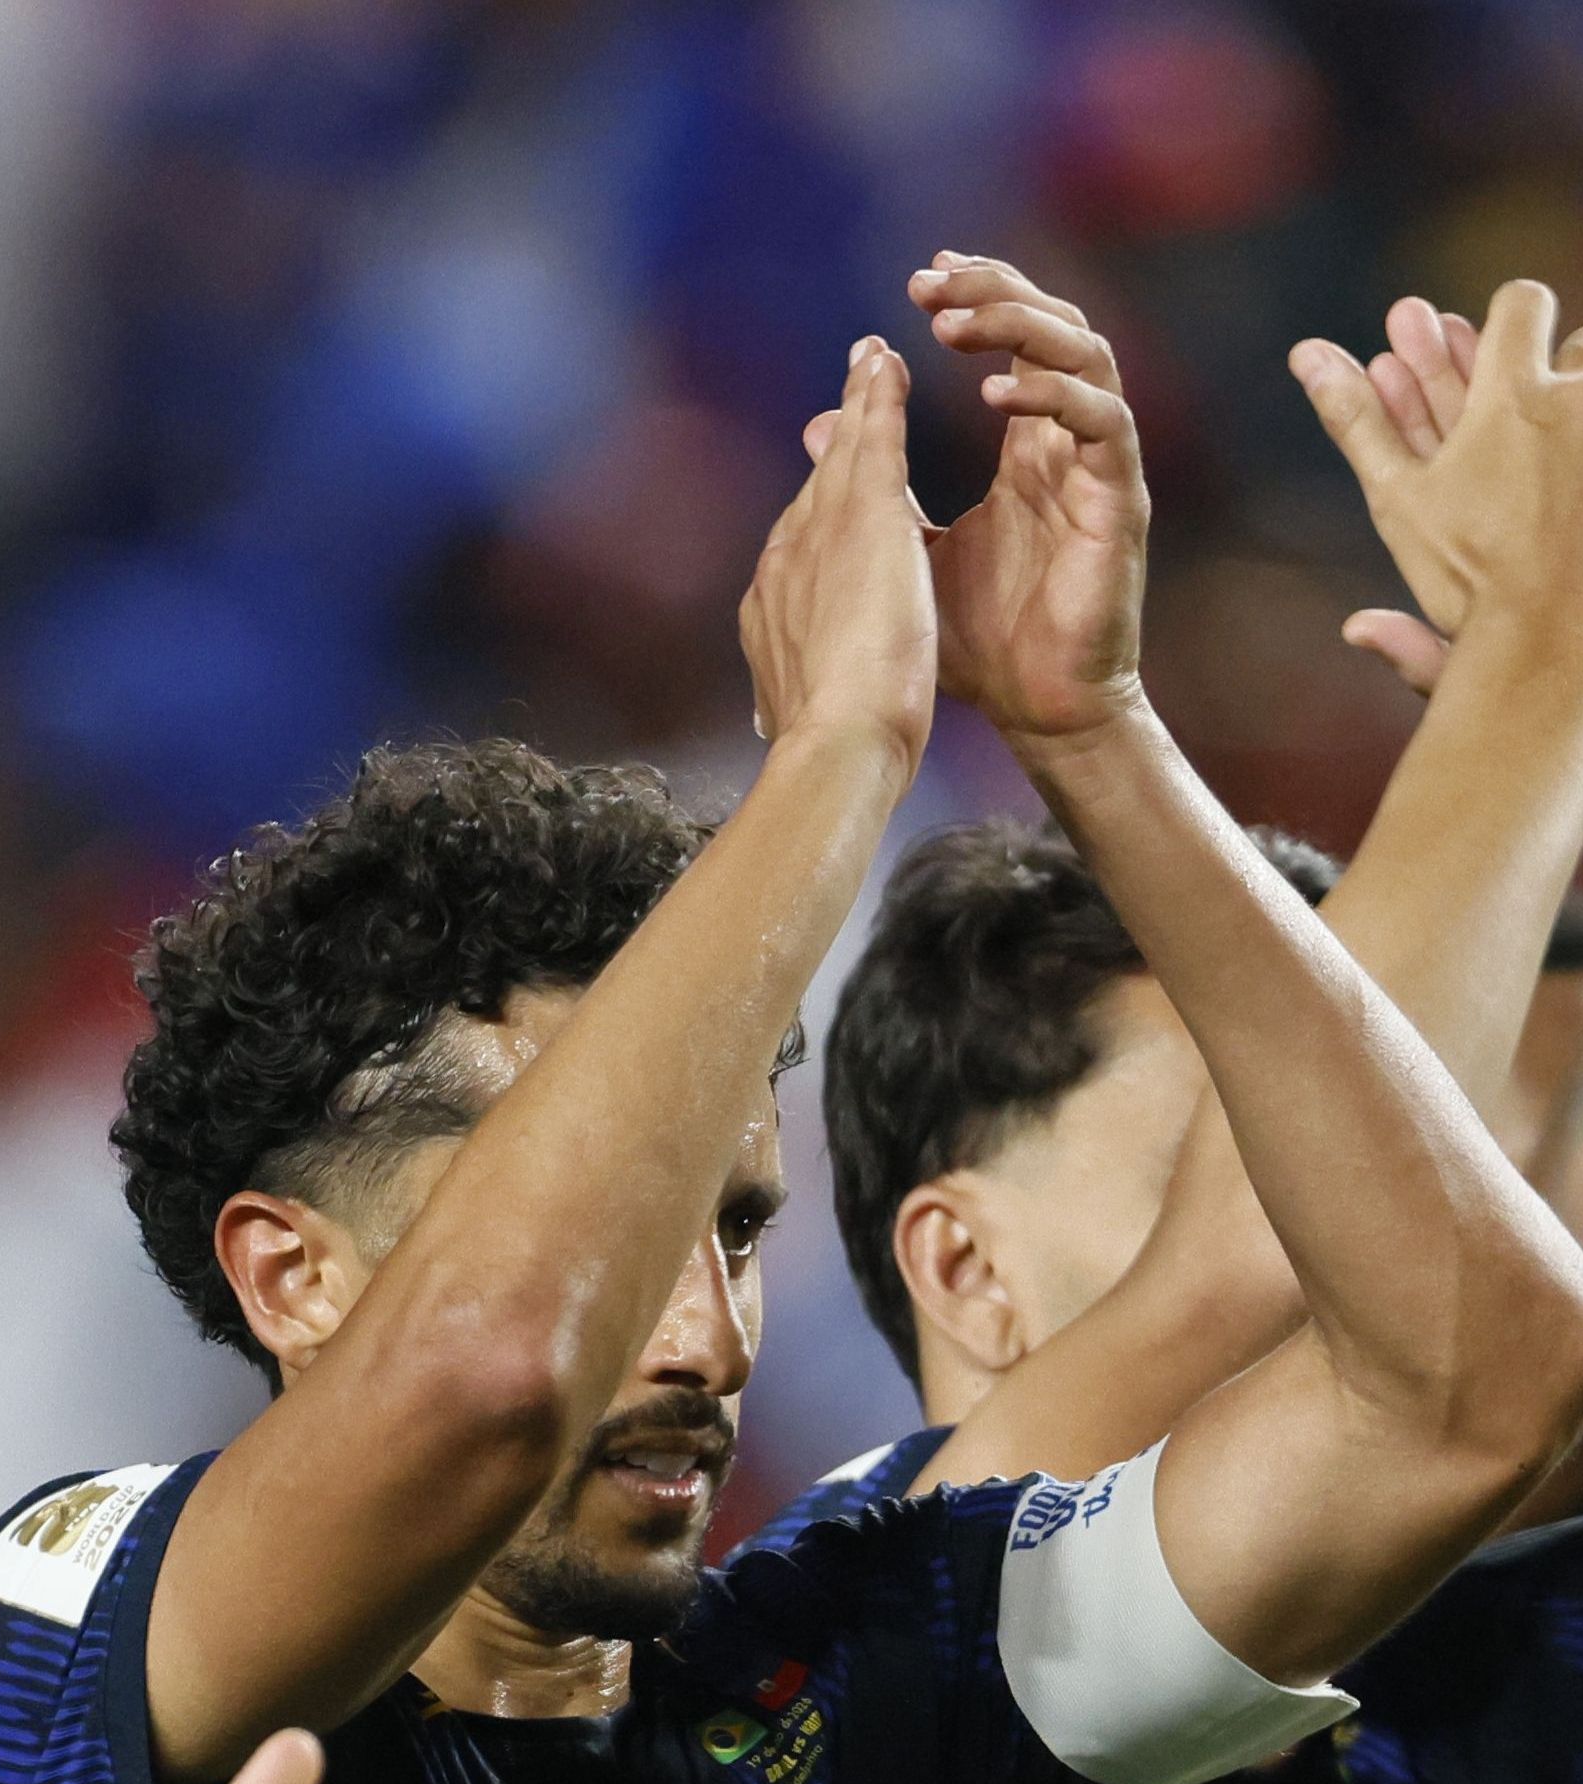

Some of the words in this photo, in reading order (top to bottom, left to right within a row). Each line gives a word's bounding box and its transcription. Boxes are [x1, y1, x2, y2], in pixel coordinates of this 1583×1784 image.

[72, 1512, 110, 1563] WORLD
[109, 1485, 134, 1510] CUP
[84, 1490, 147, 1571] 2026
